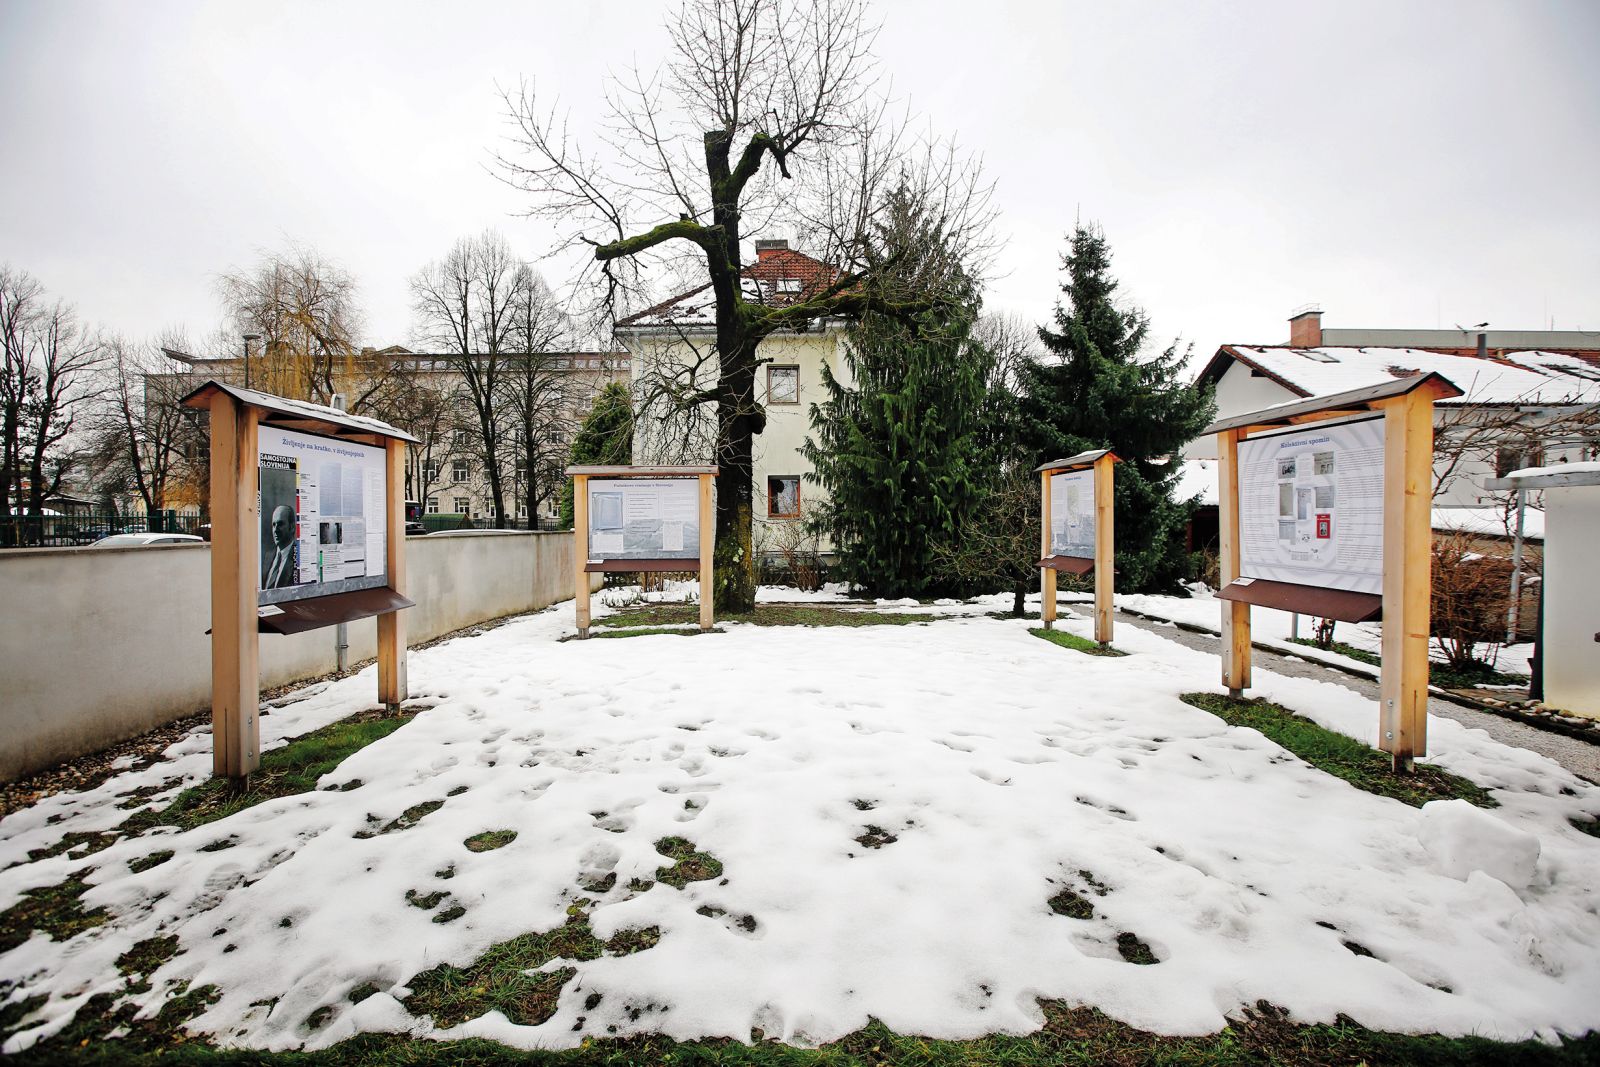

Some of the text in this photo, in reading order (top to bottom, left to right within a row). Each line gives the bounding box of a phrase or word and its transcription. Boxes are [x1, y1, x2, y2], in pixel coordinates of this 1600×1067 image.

[282, 437, 306, 449] Življenje
[1308, 436, 1330, 446] spomin
[260, 453, 297, 464] SAMOSTOJNA
[260, 460, 290, 469] SLOVENIJA
